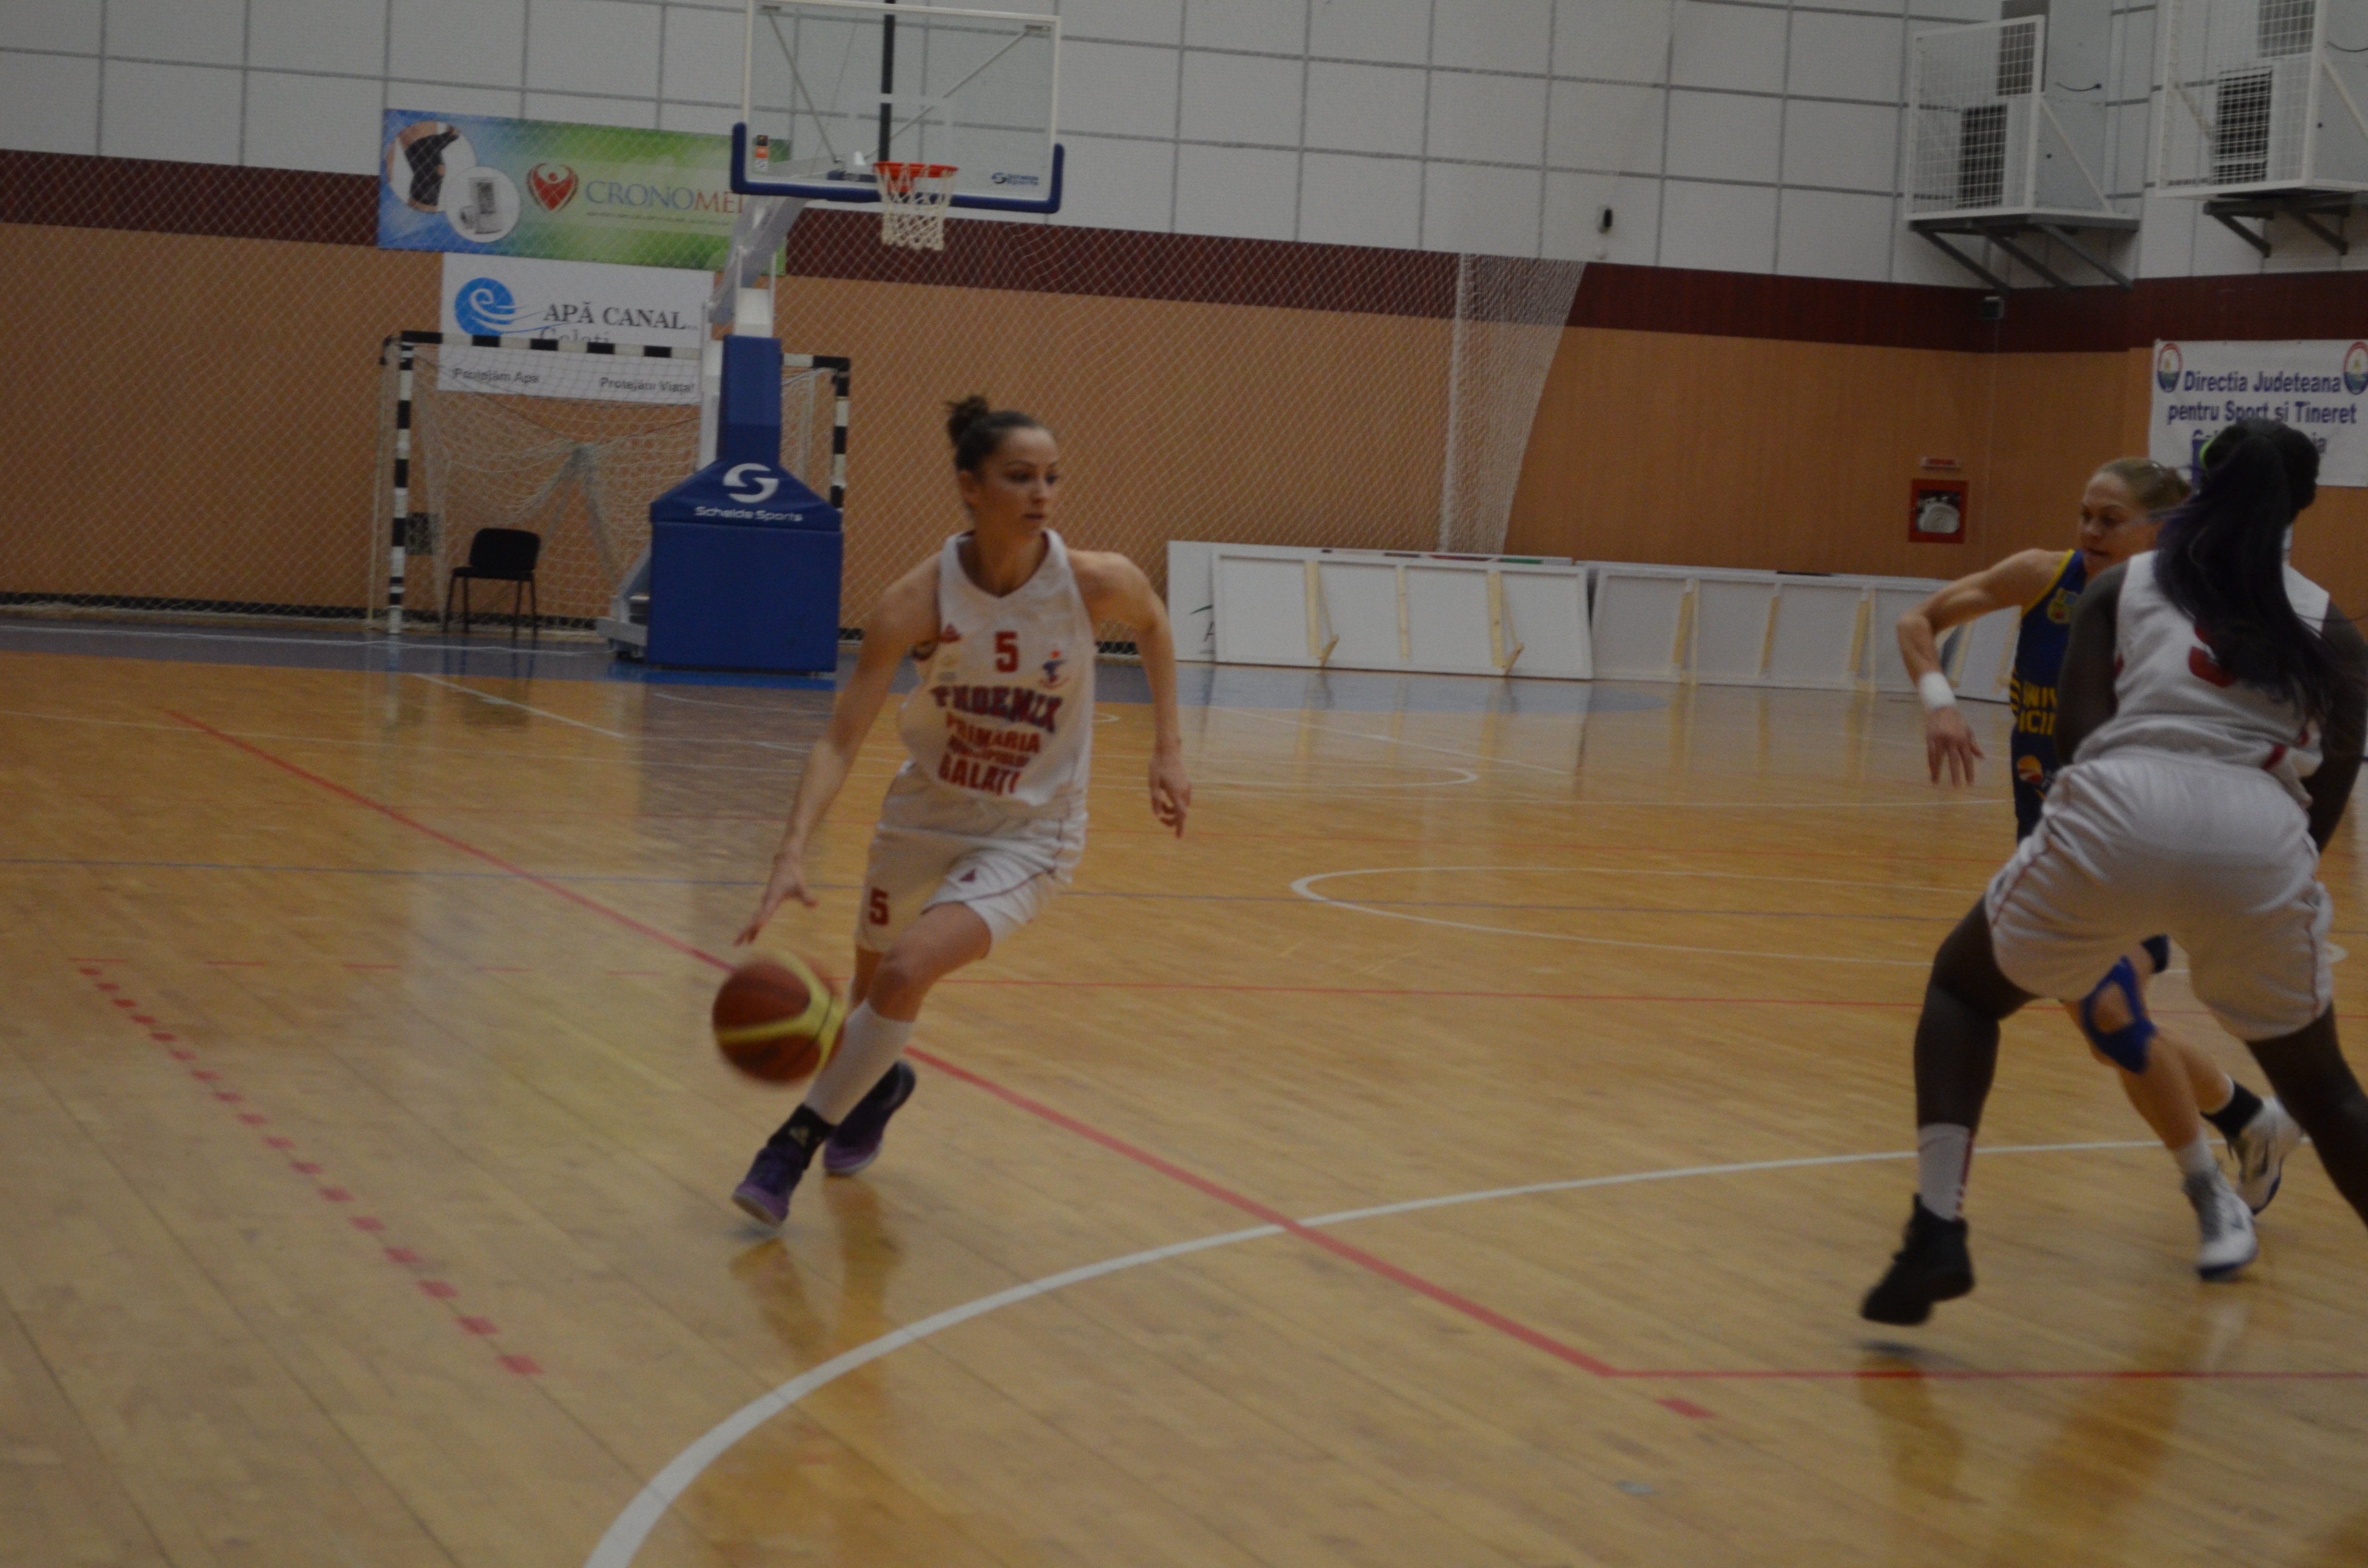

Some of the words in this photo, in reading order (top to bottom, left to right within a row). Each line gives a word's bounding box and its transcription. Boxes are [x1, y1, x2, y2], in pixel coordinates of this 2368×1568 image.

[543, 301, 595, 323] APĂ
[604, 307, 686, 330] CANAL
[2184, 370, 2247, 392] Directia
[2254, 371, 2341, 392] Judeteana
[2167, 402, 2219, 425] pentru
[2225, 400, 2269, 423] Sport
[2295, 401, 2356, 424] Tineret
[755, 510, 803, 522] Sports
[994, 630, 1019, 673] 5
[869, 887, 889, 926] 5
